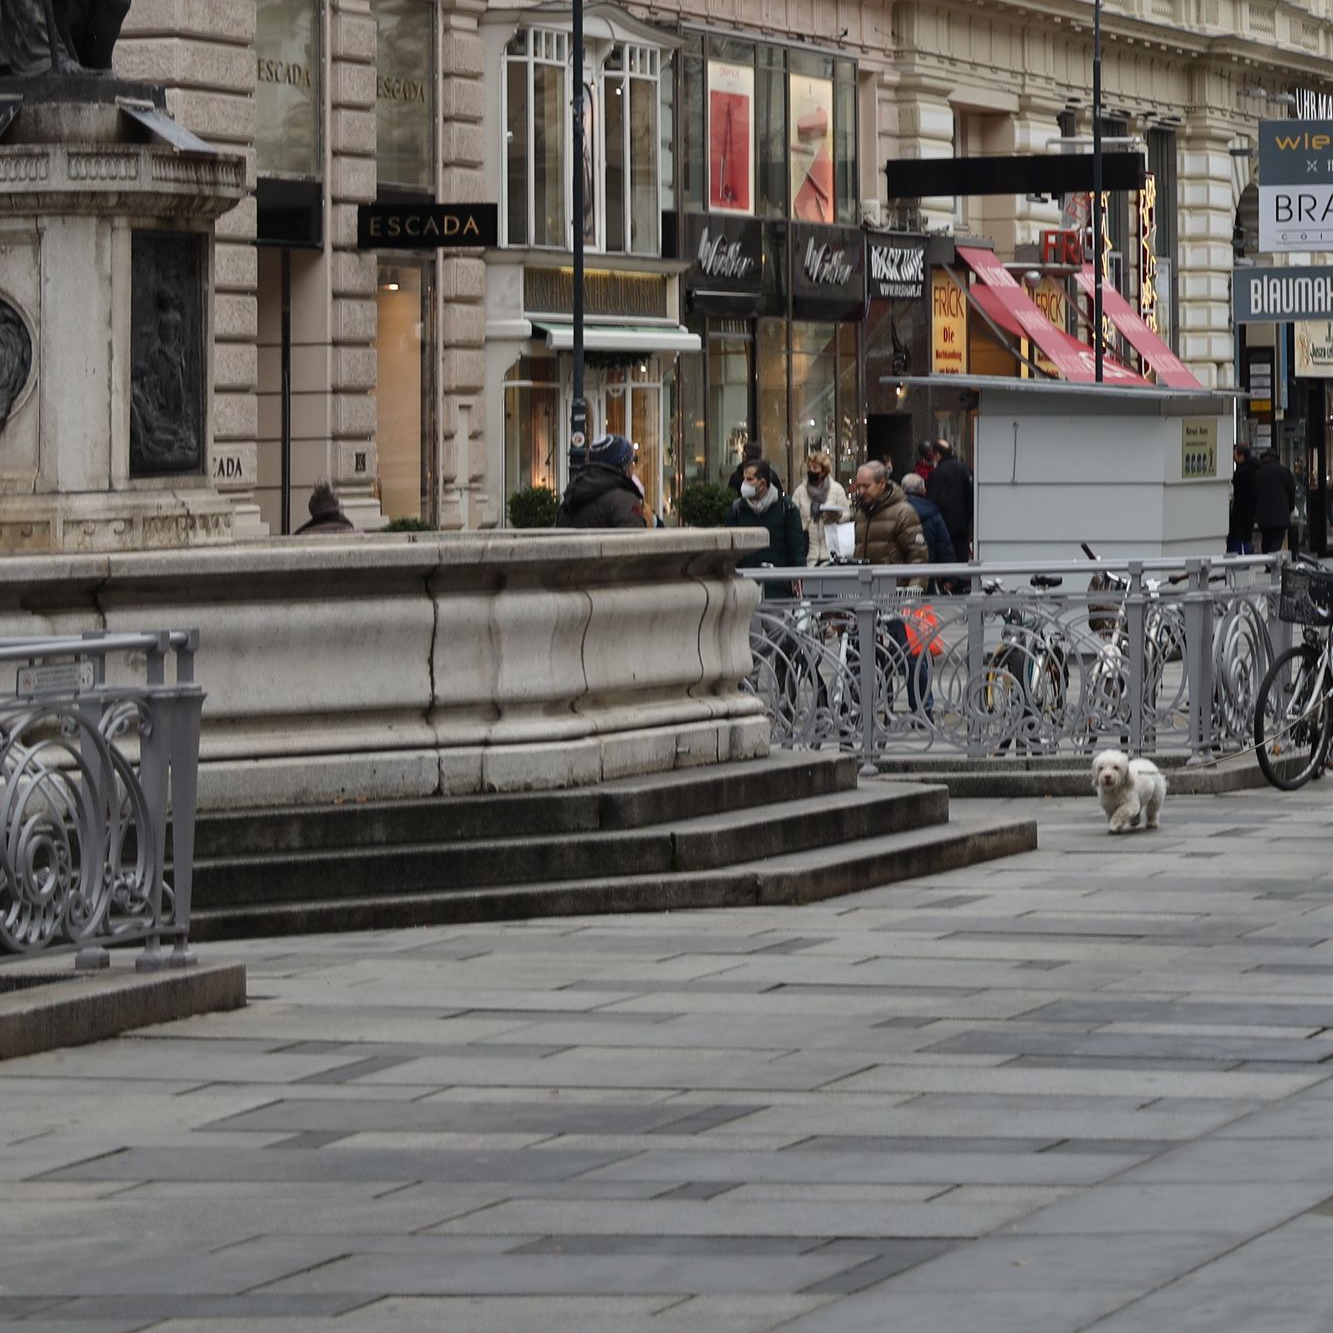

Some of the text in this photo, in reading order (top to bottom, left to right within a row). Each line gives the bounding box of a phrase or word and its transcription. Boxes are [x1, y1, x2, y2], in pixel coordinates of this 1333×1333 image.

[257, 57, 312, 89] ESCADA
[376, 76, 425, 104] ESCADA
[369, 215, 480, 237] ESCADA
[943, 326, 955, 343] Die
